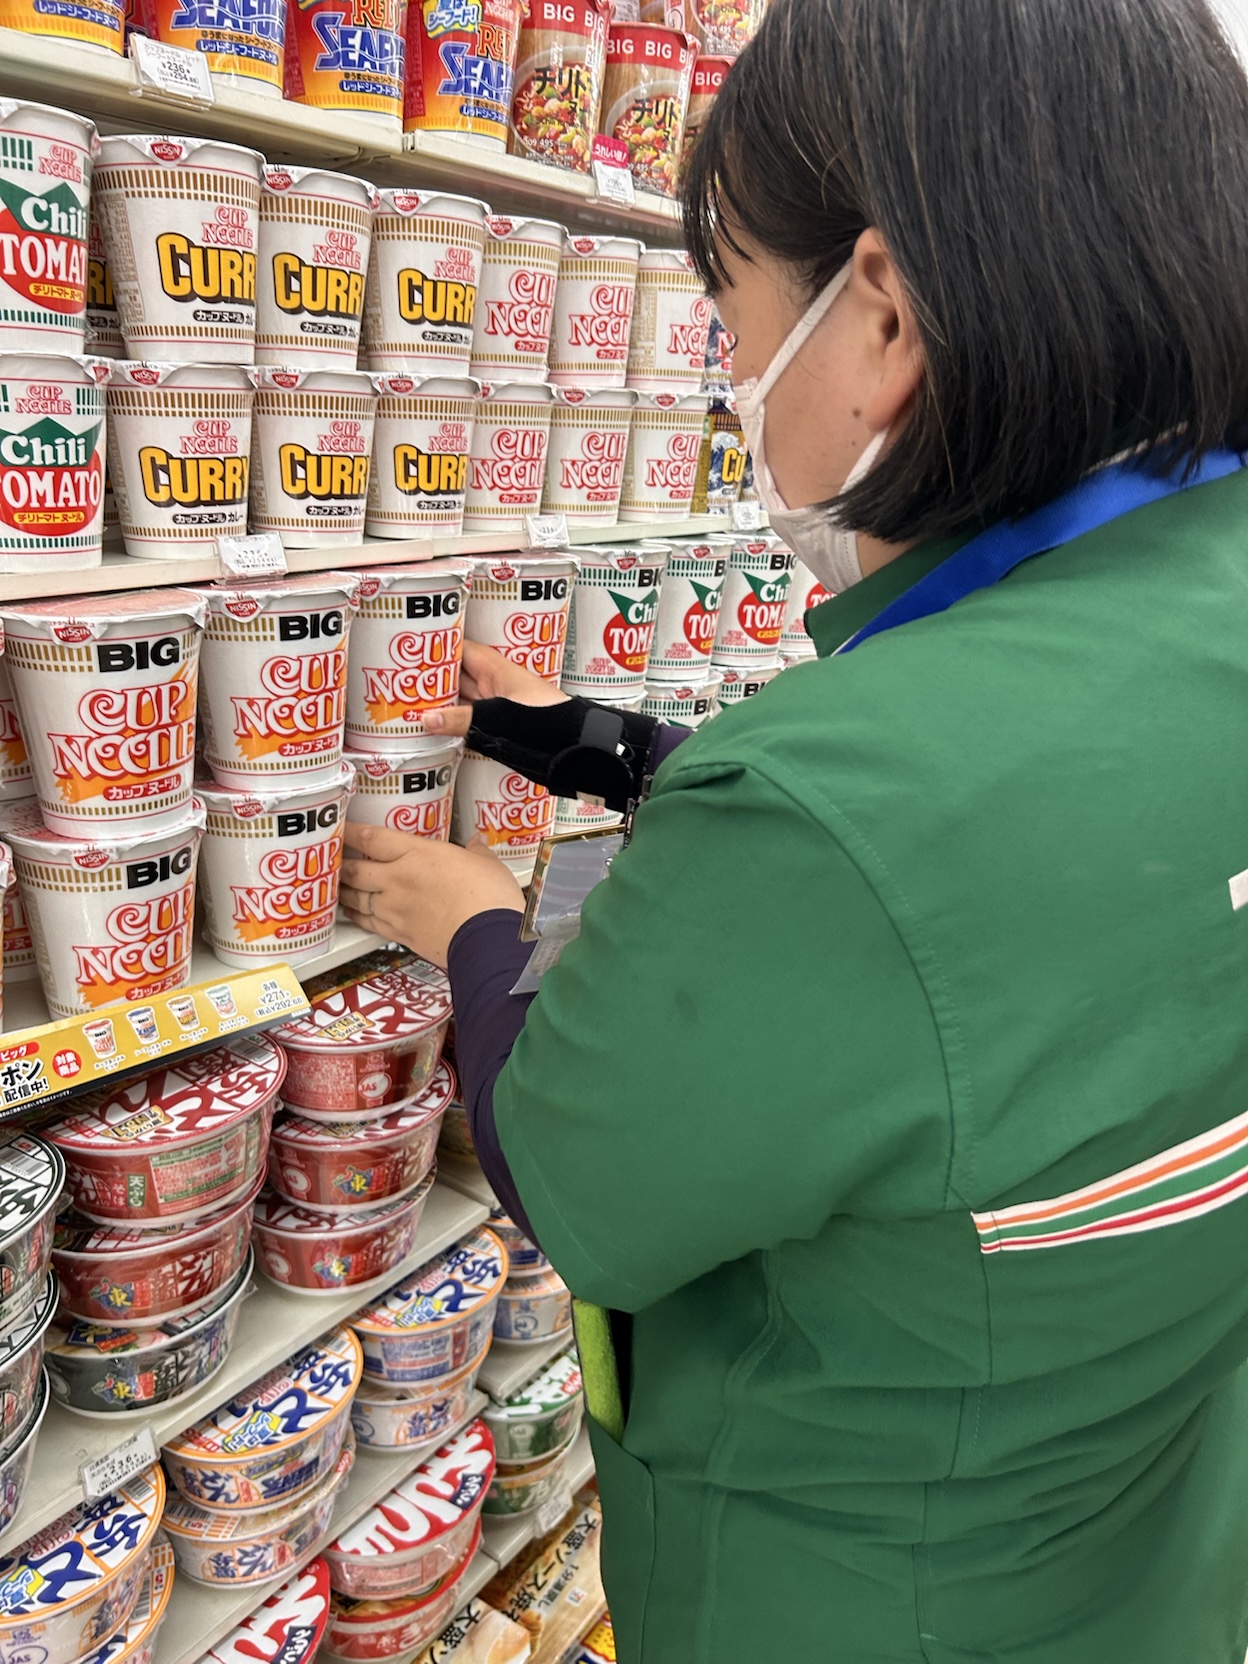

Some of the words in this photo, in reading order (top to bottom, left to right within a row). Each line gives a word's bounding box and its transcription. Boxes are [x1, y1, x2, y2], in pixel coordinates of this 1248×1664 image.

[428, 5, 477, 29] シーフード!
[543, 4, 575, 22] BIG
[607, 38, 634, 54] BIG
[645, 40, 672, 59] BIG
[695, 71, 722, 87] BIG
[50, 144, 77, 166] CUP
[20, 196, 87, 241] Chili
[214, 205, 248, 228] CUP
[325, 230, 357, 252] CUP
[445, 247, 473, 265] CUP
[26, 384, 63, 402] CUP
[192, 419, 231, 438] CUP
[329, 420, 361, 437] CUP
[439, 422, 465, 438] CUP
[1, 434, 88, 467] Chili
[0, 469, 99, 510] OMATO
[521, 578, 568, 601] BIG
[229, 602, 257, 612] NISSIN
[406, 592, 460, 619] BIG
[57, 627, 90, 638] NISSIN
[279, 611, 343, 642] BIG
[503, 612, 567, 647] CUP
[97, 637, 181, 673] BIG
[389, 627, 462, 670] CUP
[260, 649, 347, 698] CUP
[78, 680, 188, 736] CUP
[282, 735, 339, 756] カップヌードル
[107, 776, 180, 800] カップヌードル
[236, 804, 262, 815] NISSIN
[278, 803, 338, 837] BIG
[78, 852, 109, 865] NISSIN
[126, 847, 192, 890] BIG
[259, 836, 342, 887] CUP
[105, 882, 194, 944] CUP
[261, 989, 286, 1005] ¥271
[262, 980, 279, 991] 各種
[0, 1045, 28, 1062] ビッグ
[55, 1052, 77, 1066] 対象
[1, 1058, 42, 1087] ポン
[58, 1062, 80, 1076] 商品
[3, 1078, 49, 1103] 配信中!
[129, 1175, 144, 1207] 天ぷら
[28, 1527, 75, 1559] CUP
